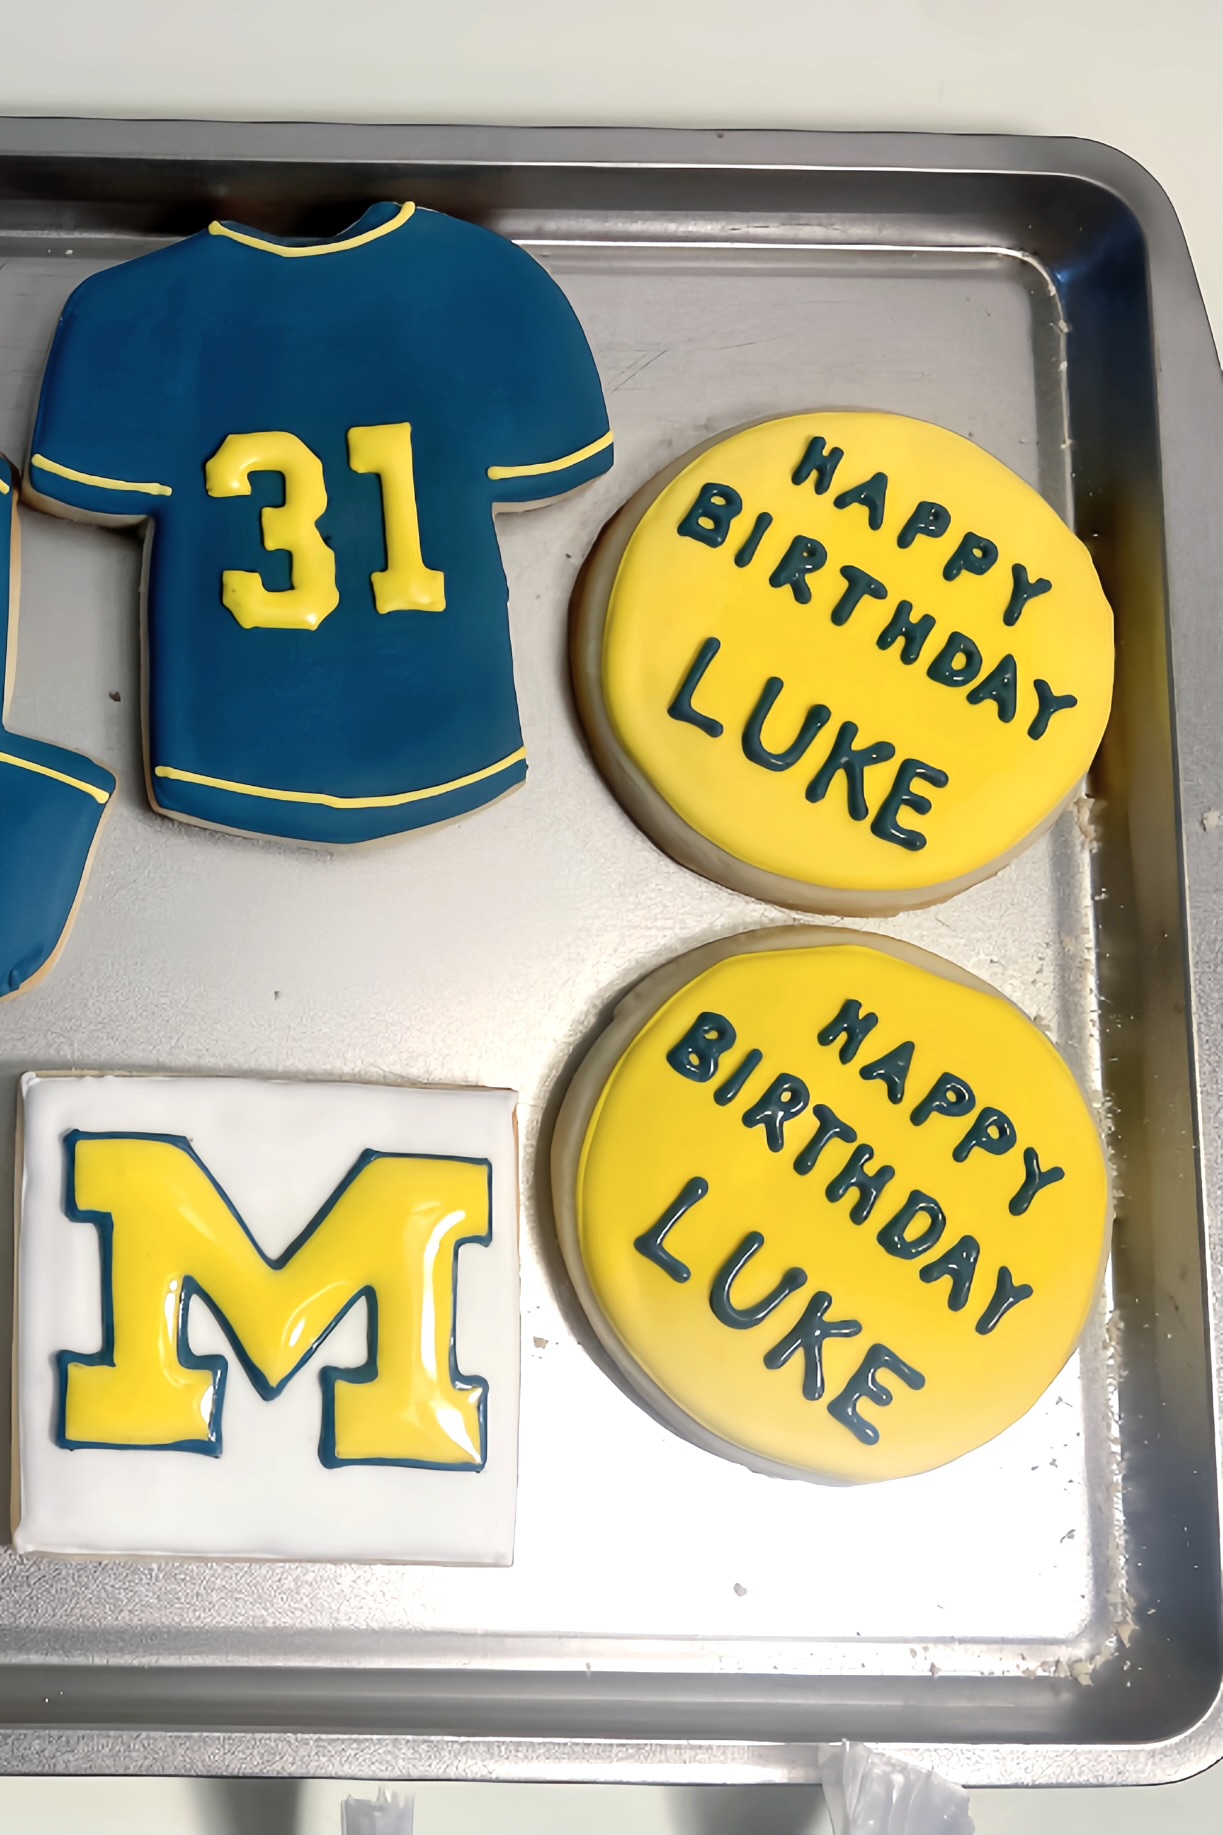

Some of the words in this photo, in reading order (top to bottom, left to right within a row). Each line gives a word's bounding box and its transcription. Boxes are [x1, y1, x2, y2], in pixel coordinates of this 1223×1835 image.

[206, 422, 447, 632] 31
[676, 482, 1078, 741] BIRTHDAY
[791, 436, 1053, 627] HAPPY
[666, 637, 949, 852] LUKE
[665, 1011, 1034, 1335] BIRTHDAY
[817, 998, 1065, 1217] HAPPY
[55, 1129, 494, 1471] M
[633, 1176, 926, 1446] LUKE
